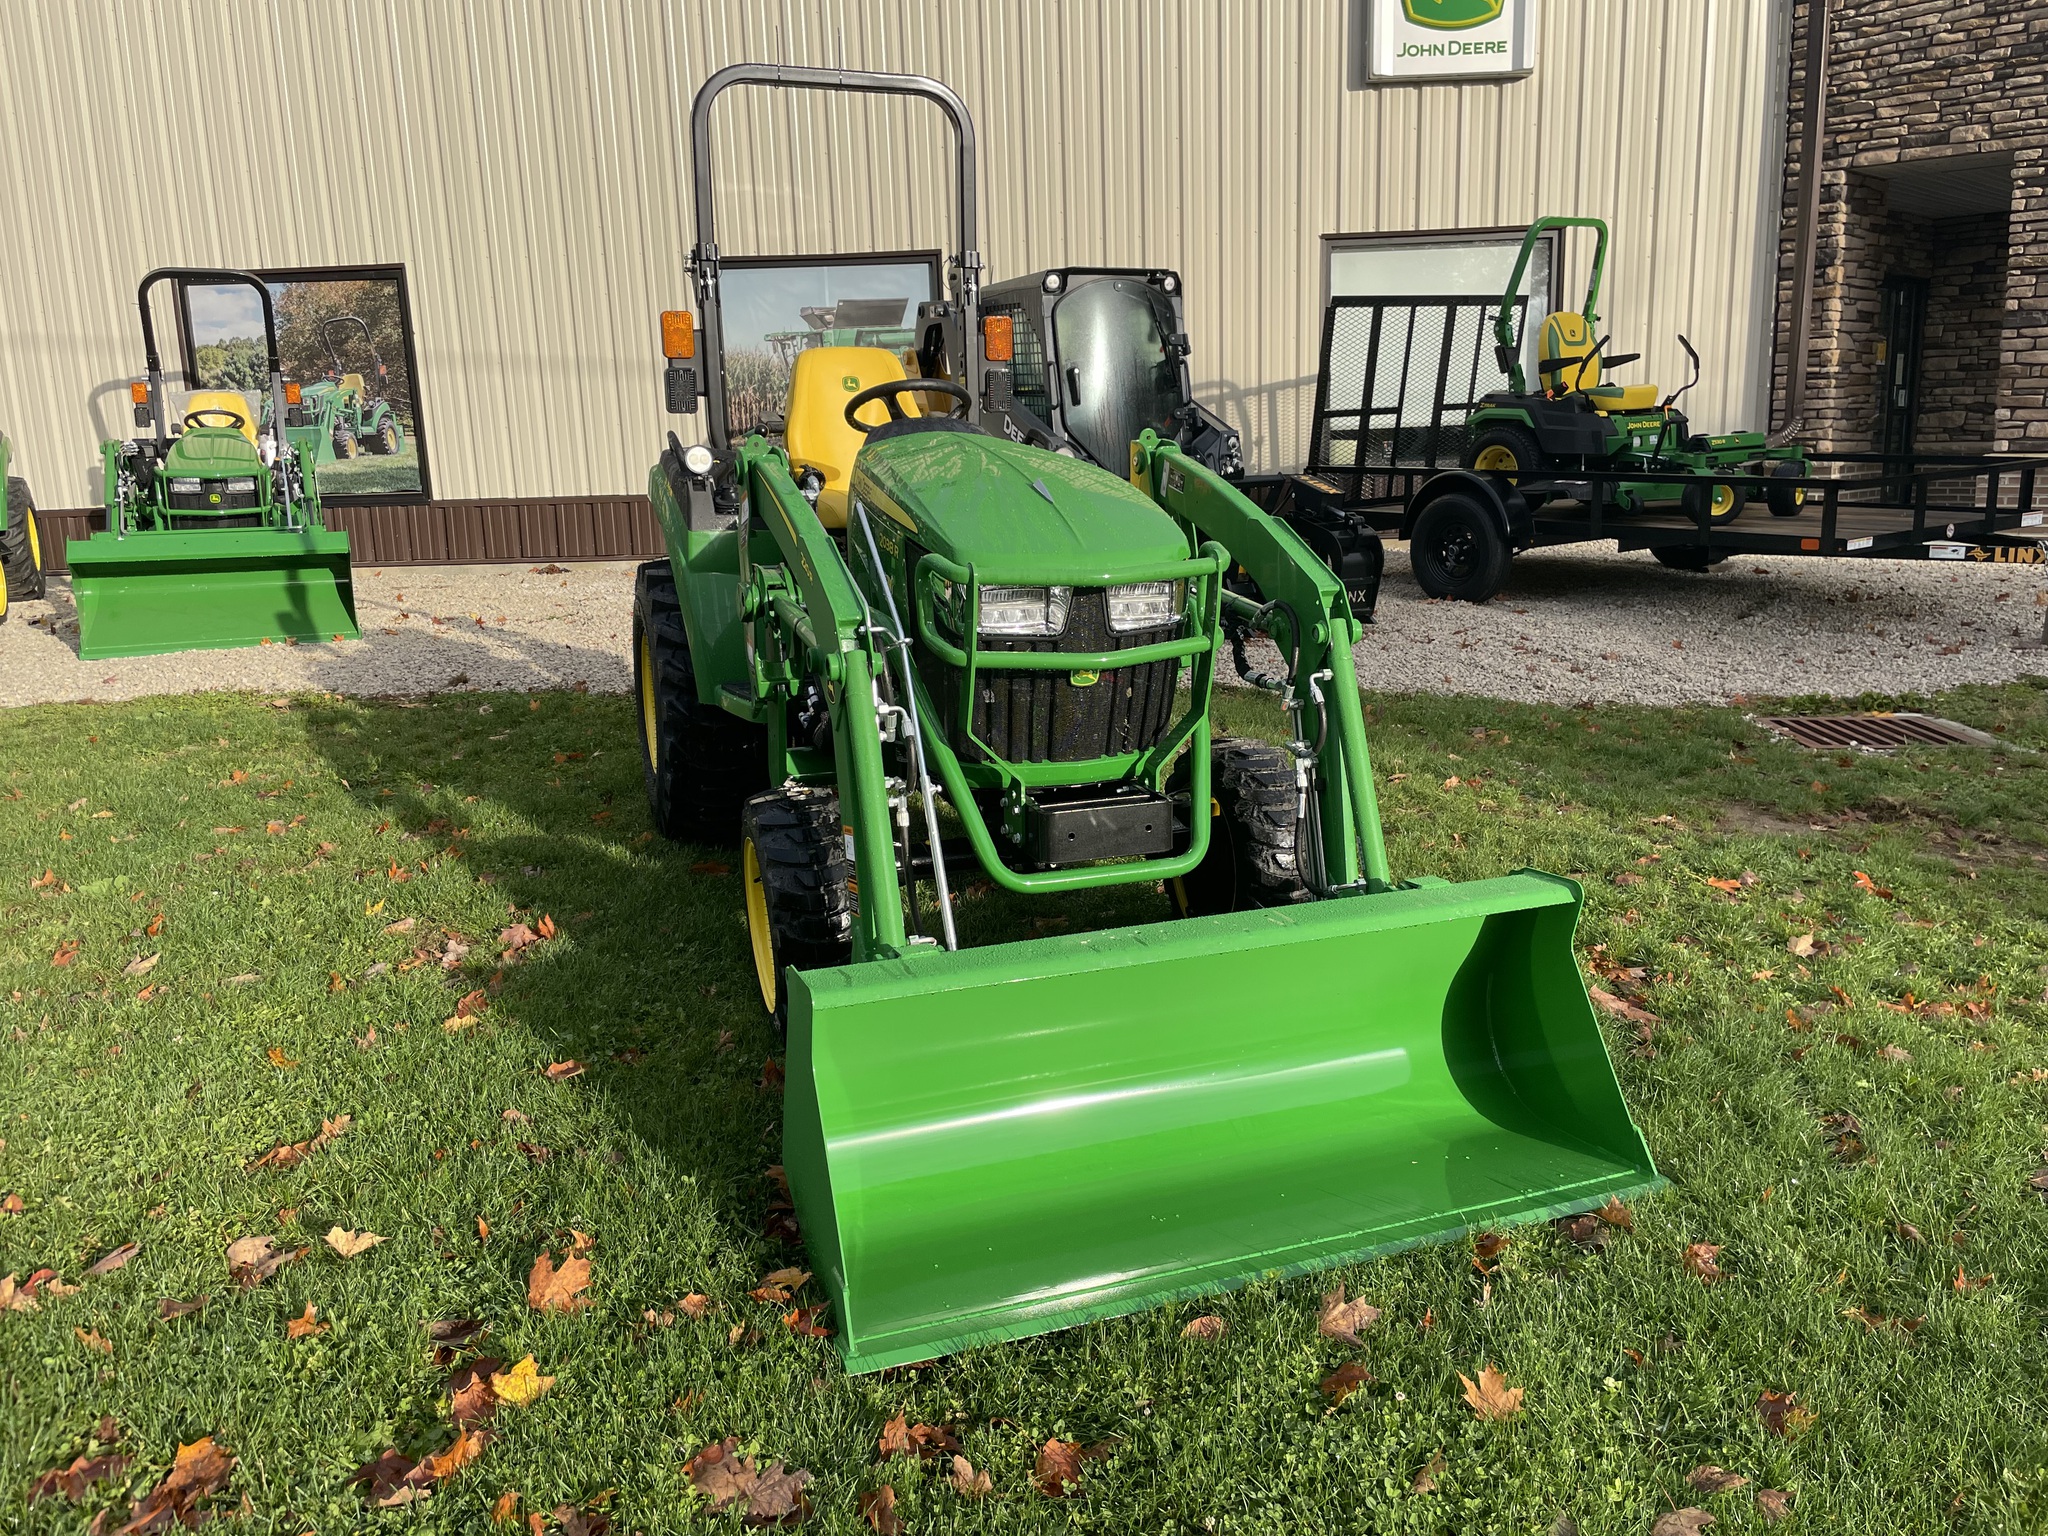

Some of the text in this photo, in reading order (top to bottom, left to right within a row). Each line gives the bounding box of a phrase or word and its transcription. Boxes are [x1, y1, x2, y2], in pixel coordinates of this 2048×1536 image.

[1396, 40, 1508, 58] JOHN DEERE
[1004, 414, 1026, 444] DEE
[1627, 420, 1661, 430] JOHN DEERE
[1994, 546, 2046, 564] LINX
[1348, 589, 1367, 603] NX
